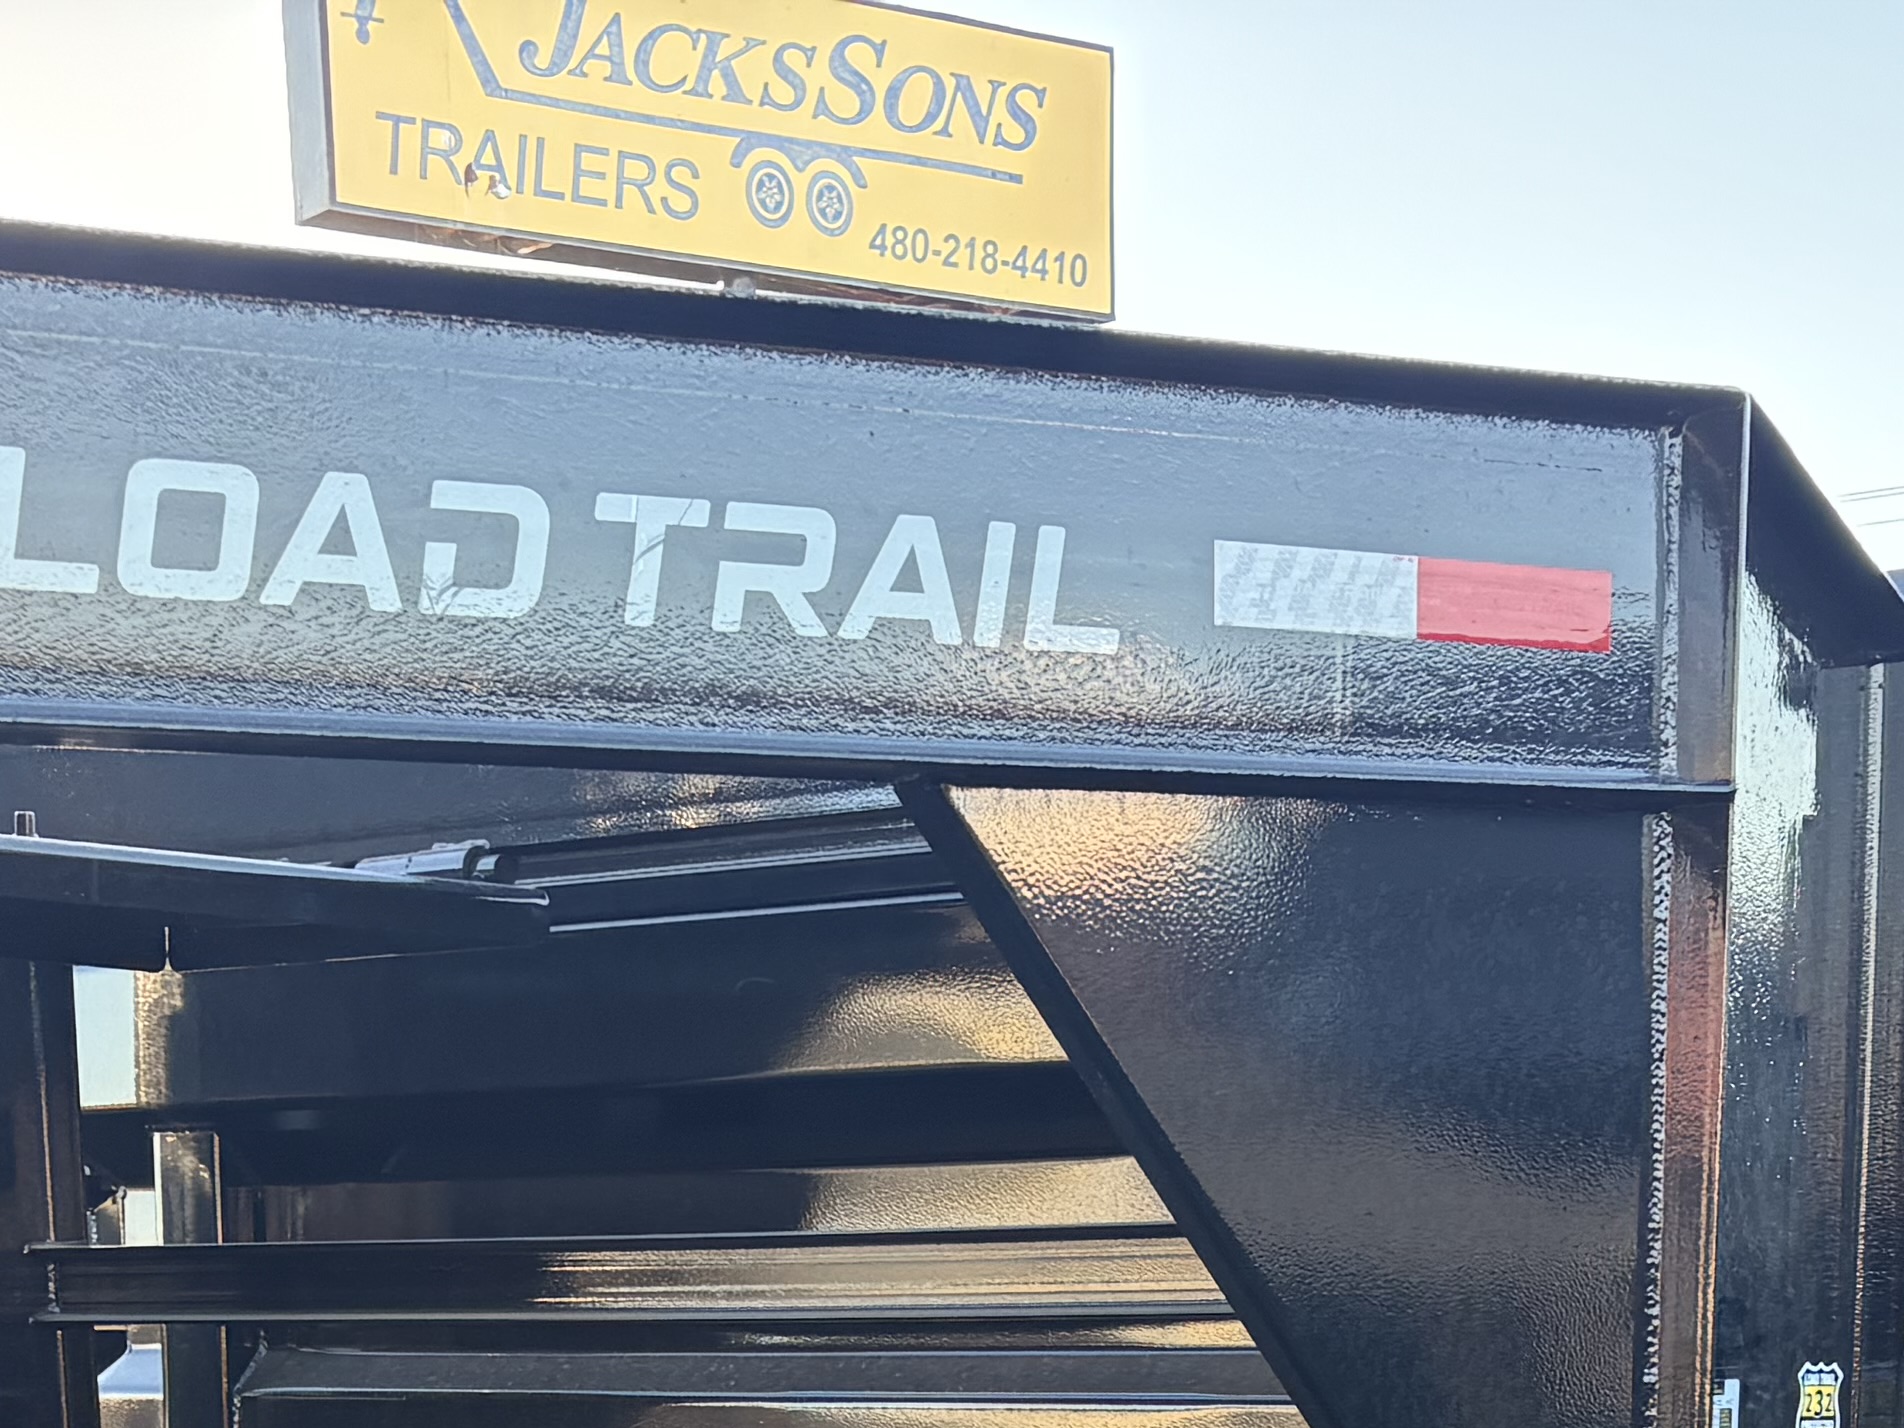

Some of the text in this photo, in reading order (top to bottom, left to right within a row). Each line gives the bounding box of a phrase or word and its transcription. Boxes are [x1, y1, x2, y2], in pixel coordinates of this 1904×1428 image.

[375, 109, 700, 222] TRAILERS
[868, 222, 1089, 290] 480-218-4410
[593, 491, 1122, 656] TRAIL
